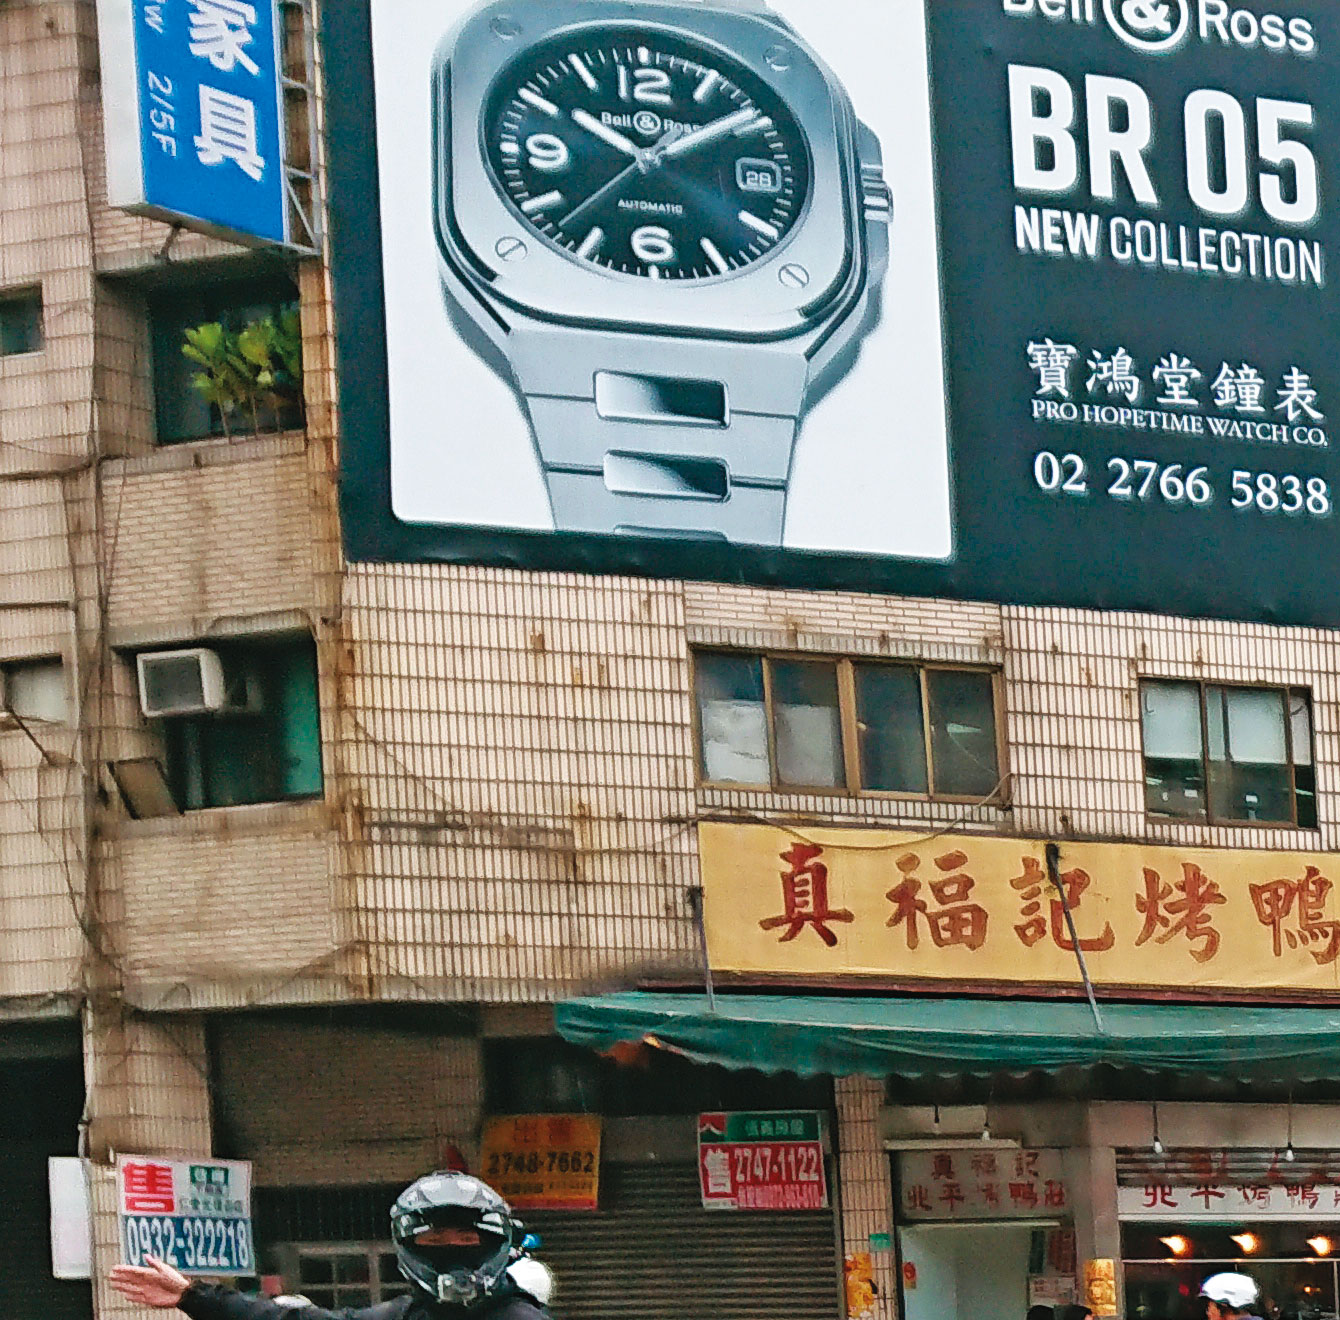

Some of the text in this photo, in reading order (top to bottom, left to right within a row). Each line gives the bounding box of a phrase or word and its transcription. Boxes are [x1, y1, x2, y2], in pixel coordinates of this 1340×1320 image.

[1198, 0, 1316, 53] Ross
[617, 64, 672, 104] 12
[147, 71, 177, 157] 2/5F
[601, 111, 632, 127] Bell
[1007, 63, 1319, 224] BR 05
[617, 199, 684, 215] AUTOMATIC
[1014, 205, 1323, 285] NEW COLLECTION
[1026, 337, 1325, 423] 寶鴻堂鐘表
[1031, 399, 1329, 448] PRO HOPETIME WATCH CO.
[1034, 451, 1331, 515] 02 2766 5838
[122, 1162, 175, 1213] 售
[704, 1147, 733, 1194] 售
